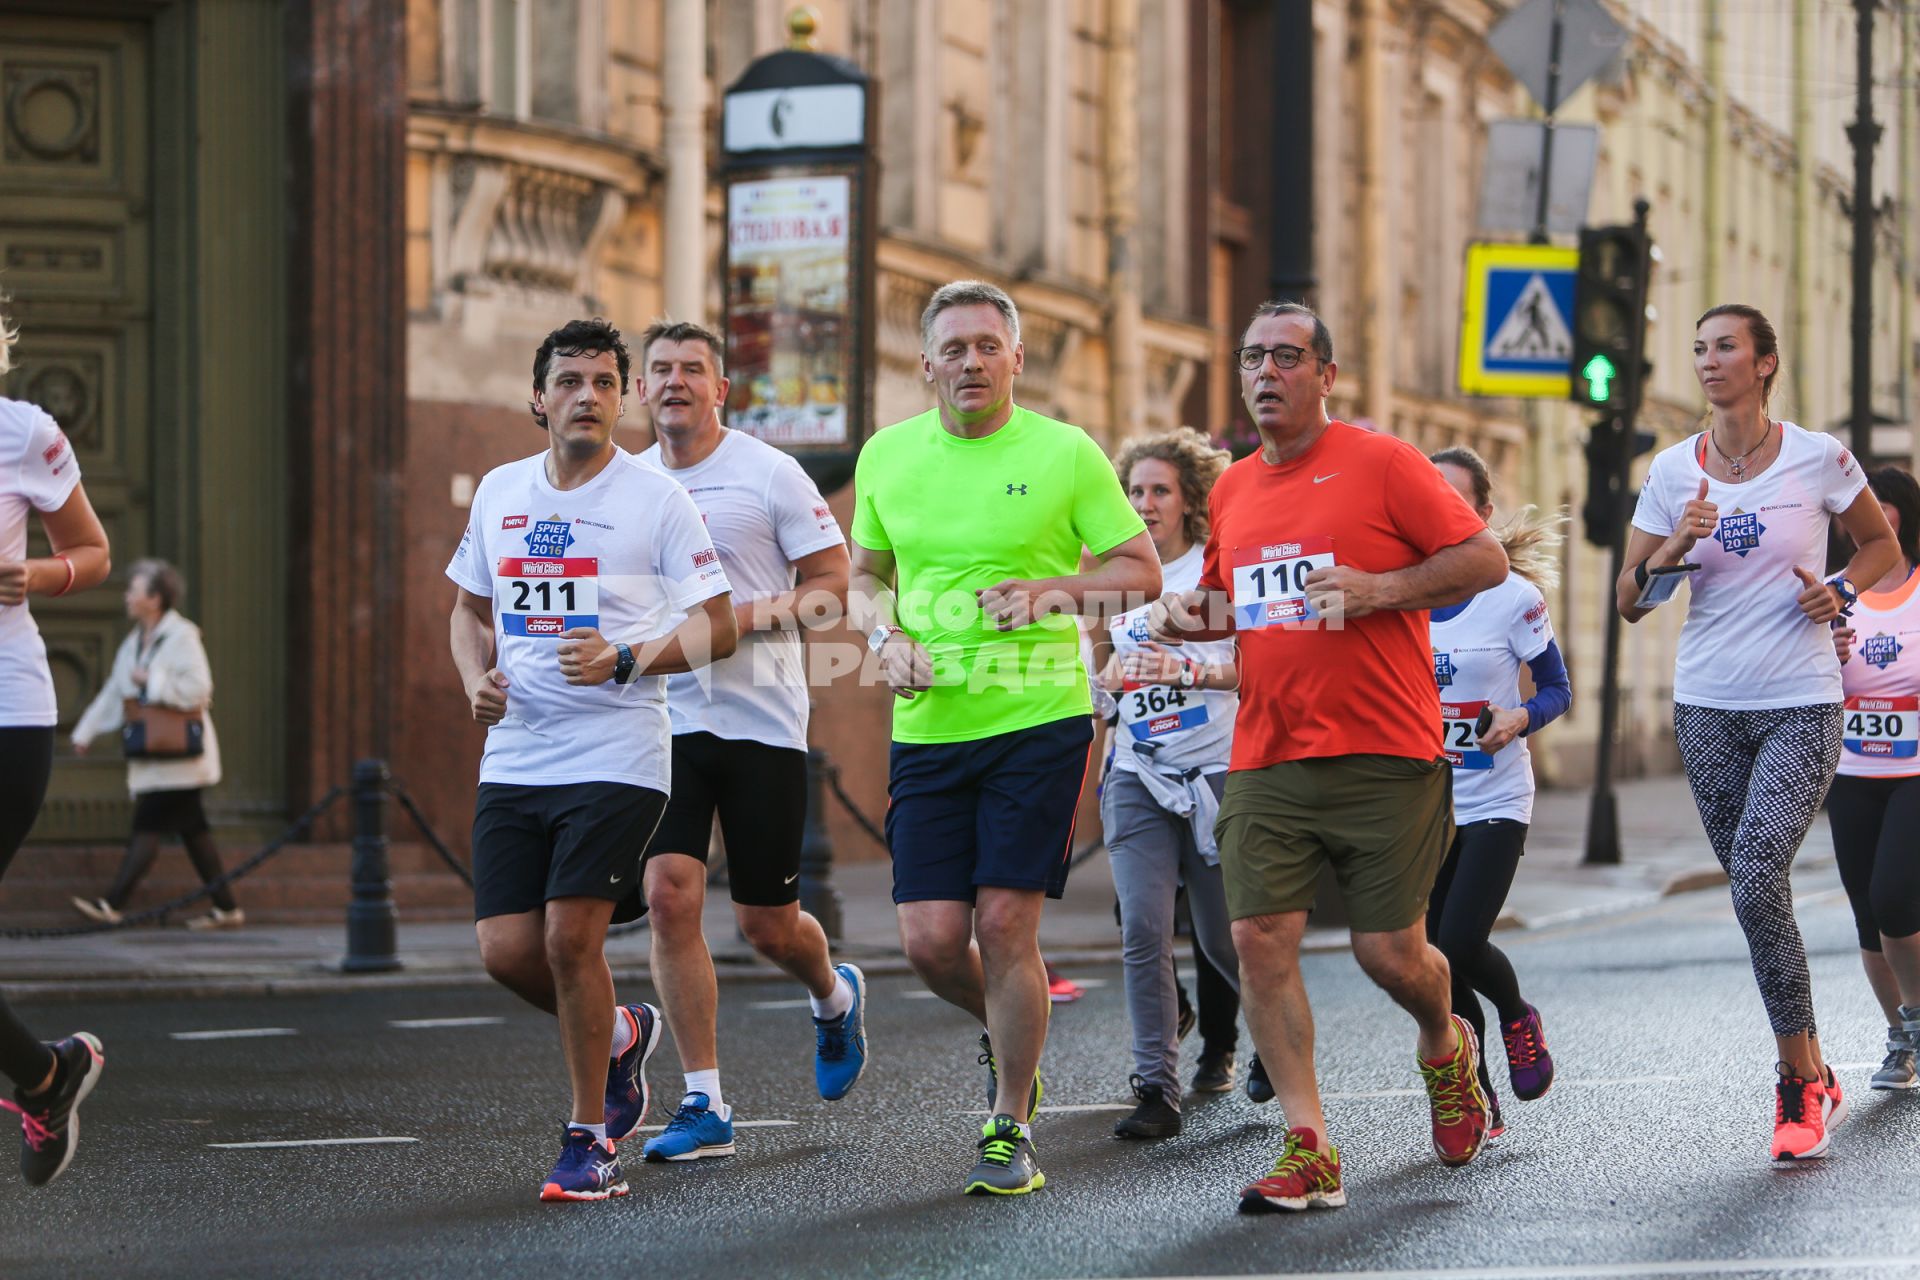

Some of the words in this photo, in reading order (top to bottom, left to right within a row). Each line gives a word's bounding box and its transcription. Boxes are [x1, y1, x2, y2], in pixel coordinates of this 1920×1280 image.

[537, 523, 568, 534] SPIEF
[1723, 516, 1754, 529] SPIEF
[1724, 525, 1755, 539] RACE
[533, 534, 565, 545] RACE
[1725, 536, 1756, 549] 2016
[531, 544, 562, 555] 2016
[1262, 546, 1281, 559] World
[1282, 543, 1301, 556] Class
[523, 562, 543, 574] World
[543, 562, 564, 574] Class
[1250, 560, 1314, 598] 110
[512, 581, 575, 611] 211
[1268, 606, 1303, 617] СПОРТ
[1435, 665, 1449, 675] CE
[1133, 685, 1187, 718] 364
[1847, 714, 1903, 737] 430
